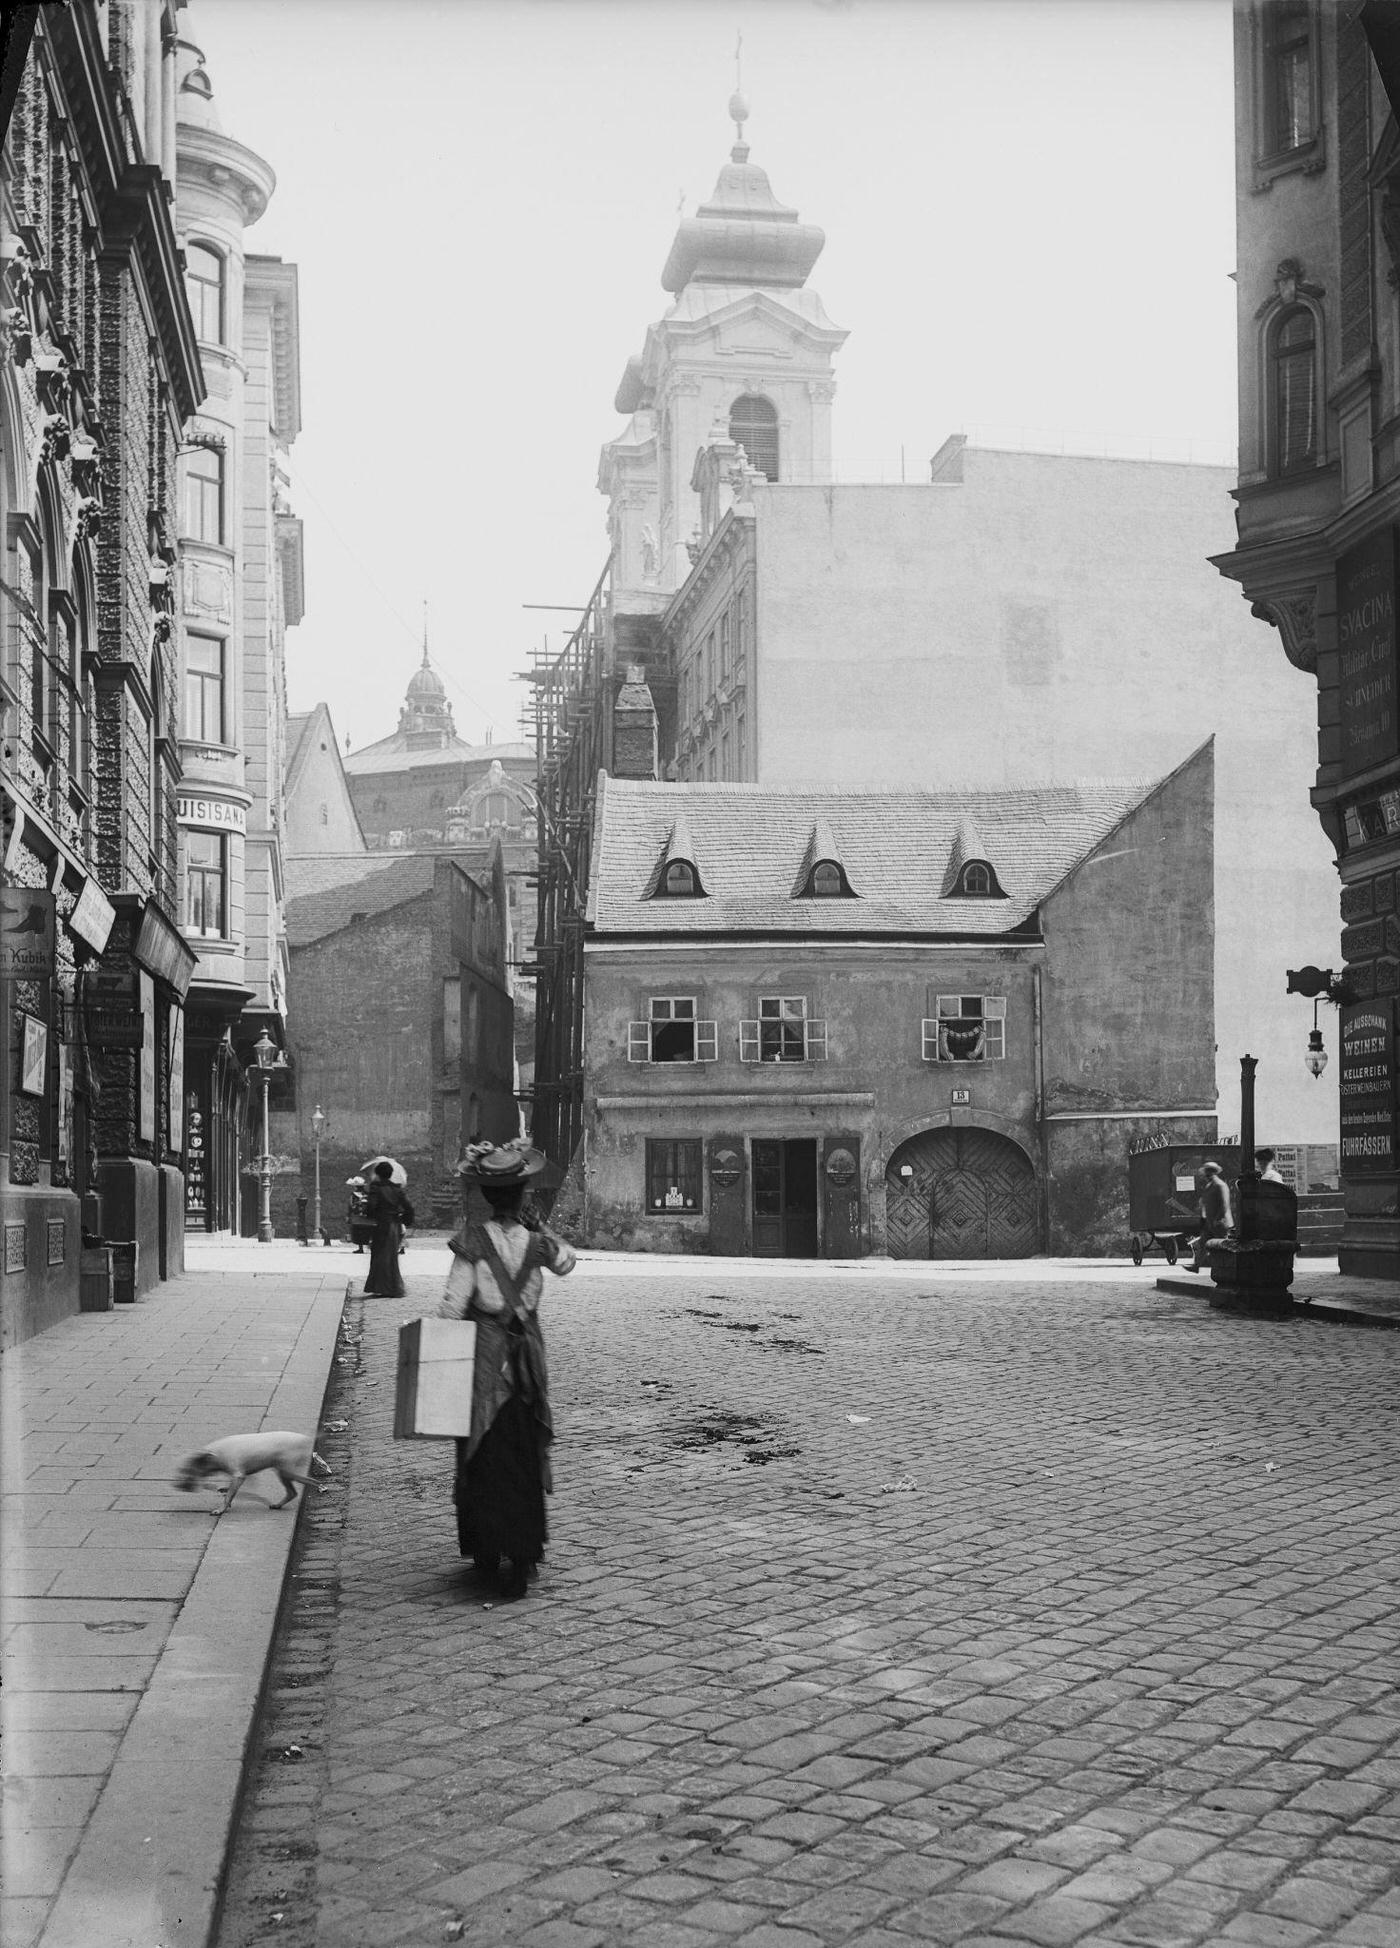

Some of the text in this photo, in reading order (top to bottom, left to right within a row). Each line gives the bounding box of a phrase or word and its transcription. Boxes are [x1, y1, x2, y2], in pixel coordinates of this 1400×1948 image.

[9, 948, 47, 965] Kubik
[1344, 1036, 1386, 1056] WEINEN
[1343, 1064, 1388, 1080] KELLEREIEN
